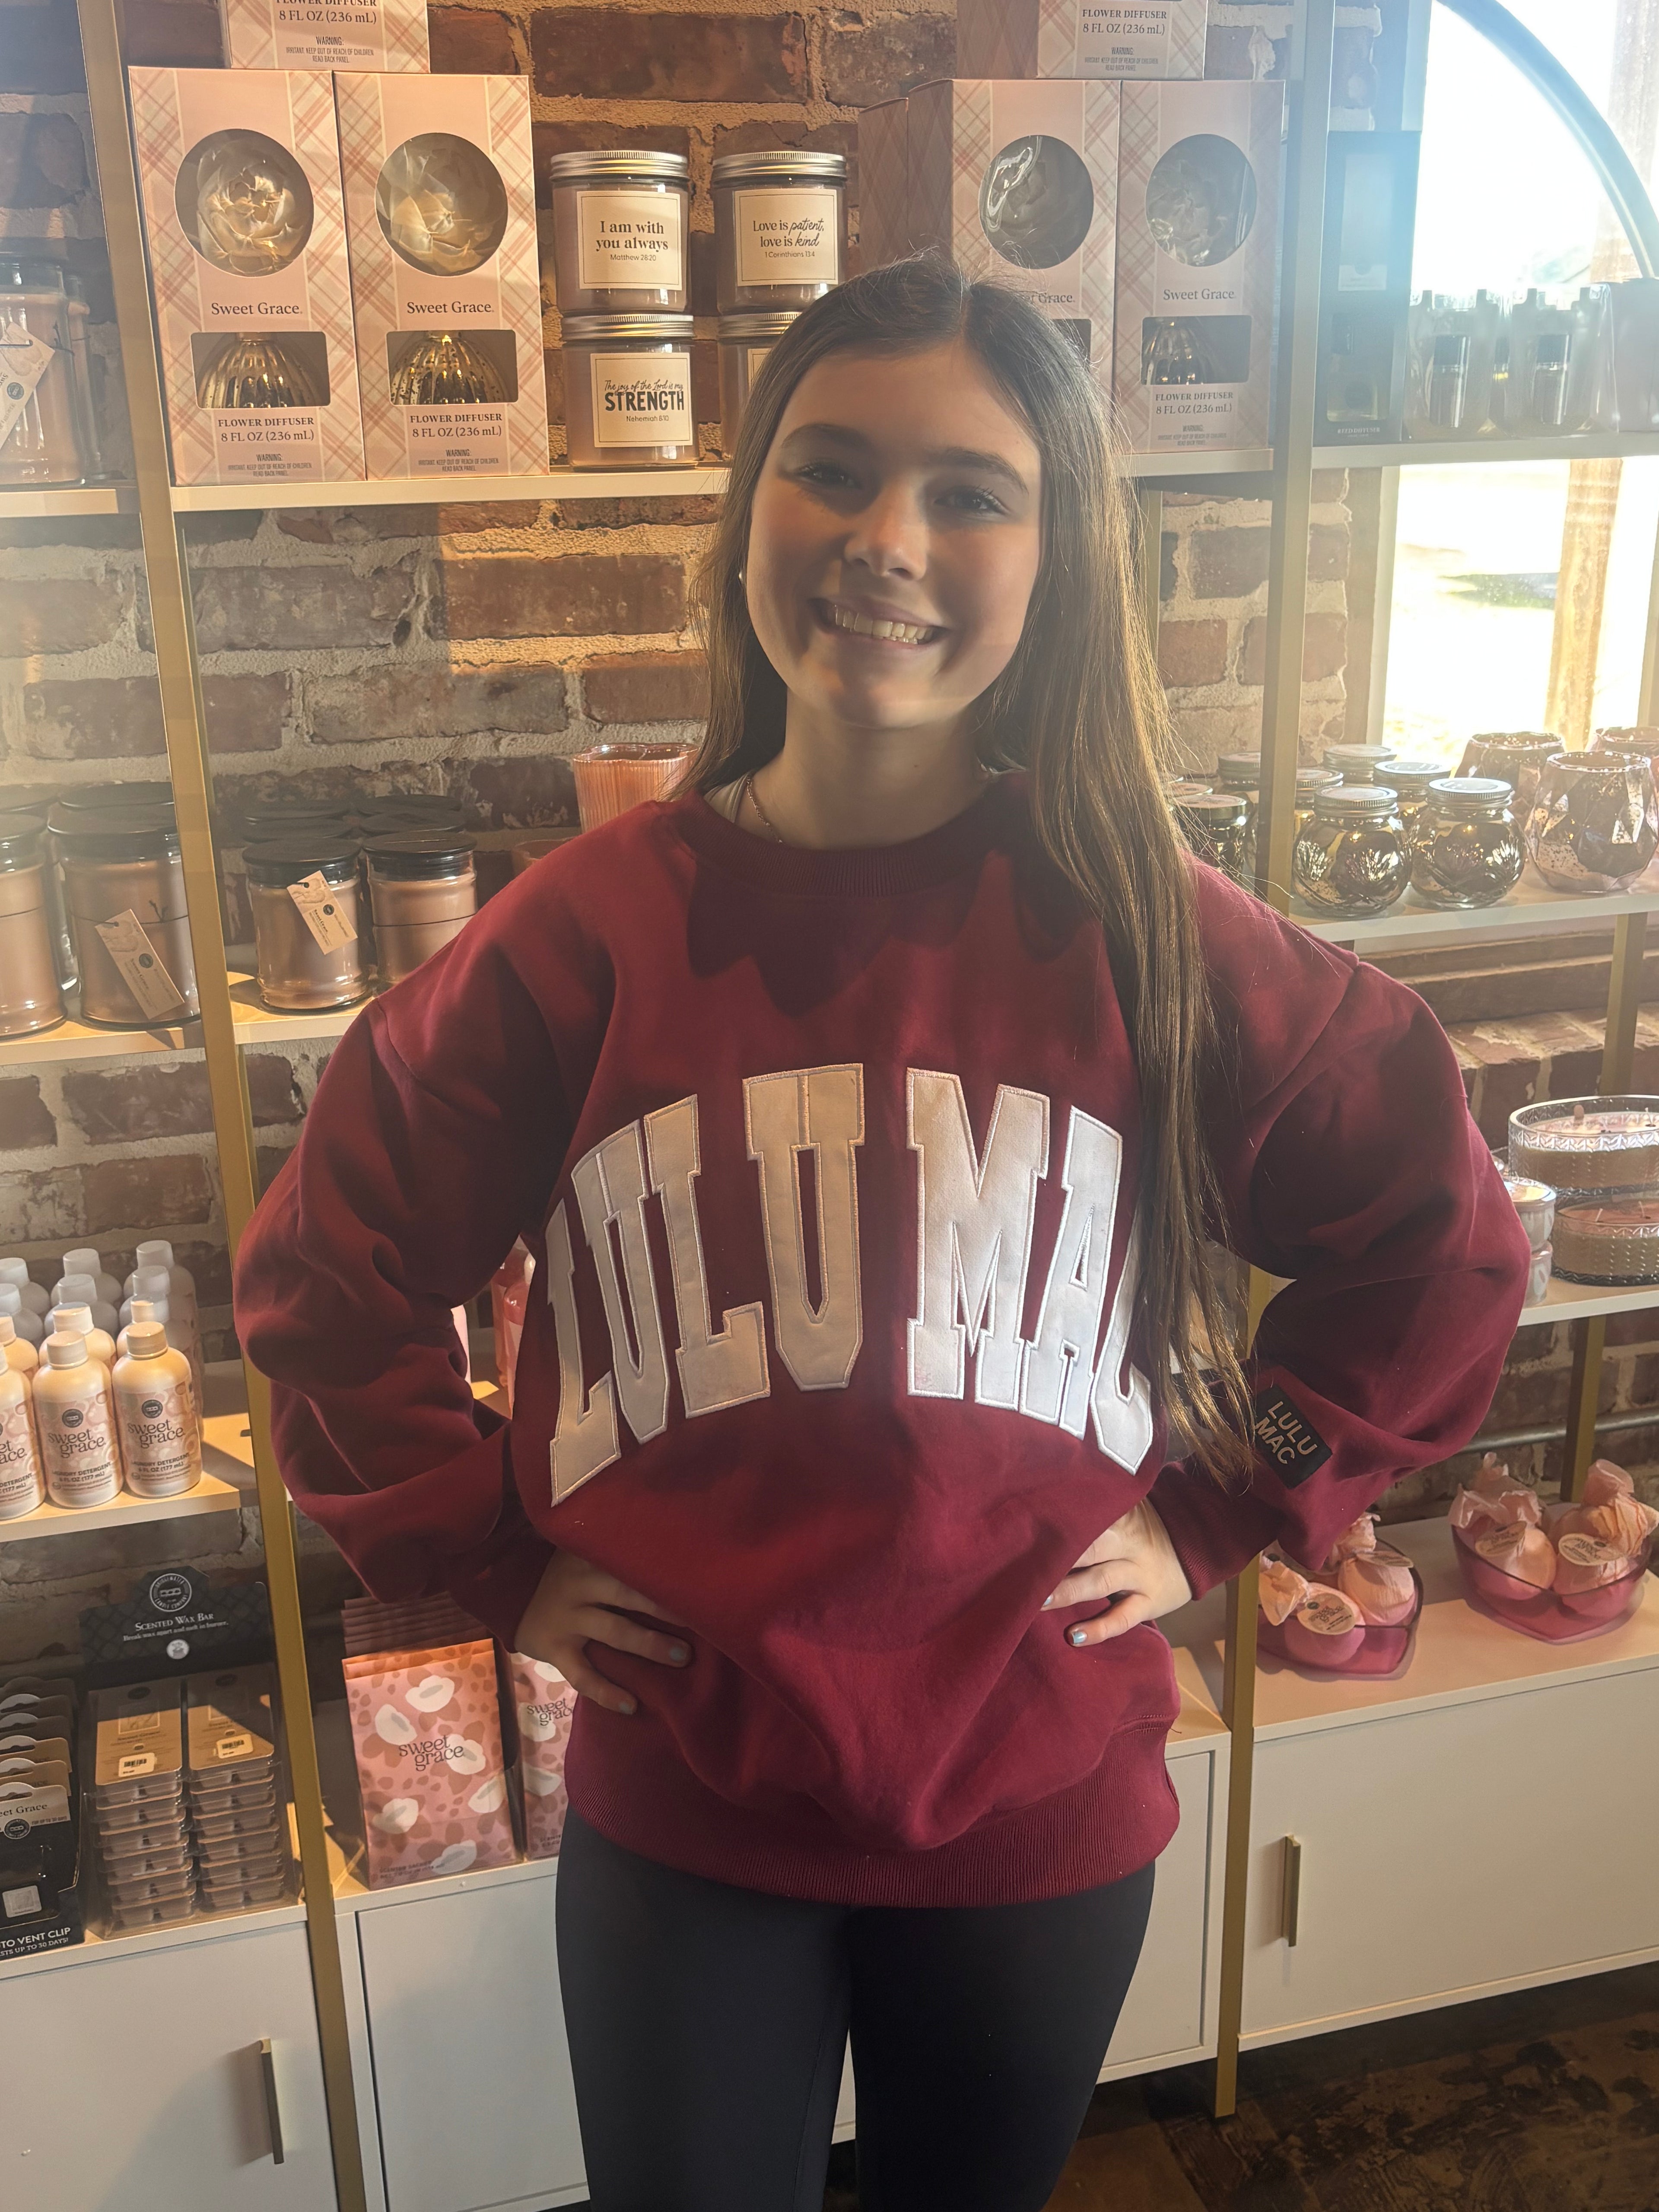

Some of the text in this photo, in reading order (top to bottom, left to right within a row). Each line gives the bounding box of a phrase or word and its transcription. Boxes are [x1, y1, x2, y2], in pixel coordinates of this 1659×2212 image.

[280, 10, 376, 24] 8 FL OZ (236 mL)
[1083, 10, 1166, 19] FLOWER DIFFUSER
[1083, 23, 1165, 35] 8 FL OZ (236 mL)
[601, 221, 664, 234] I am with
[753, 218, 824, 235] Love is patient,
[596, 237, 668, 252] you always
[760, 232, 820, 247] love is kind
[1163, 289, 1198, 300] Sweet
[211, 302, 254, 315] Sweet
[407, 302, 448, 314] Sweet
[605, 380, 616, 391] The
[640, 379, 652, 390] the
[605, 391, 684, 411] STRENGTH
[1178, 405, 1191, 413] OZ
[1193, 404, 1213, 414] (236
[1216, 403, 1232, 413] mL)
[265, 418, 314, 426] DIFFUSER
[455, 413, 502, 422] DIFFUSER
[221, 429, 314, 442] 8 FL OZ (236 mL)
[413, 426, 502, 438] 8 FL OZ (236 mL)
[545, 1063, 1153, 1508] LULU MAC
[127, 1419, 172, 1434] sweet
[1268, 1401, 1318, 1456] LULU
[48, 1429, 93, 1443] sweet
[1254, 1417, 1295, 1465] MAC
[135, 1619, 173, 1631] SCENTED
[197, 1613, 214, 1621] BAR
[527, 1697, 568, 1714] sweet
[540, 1707, 572, 1726] grac
[399, 1735, 450, 1757] sweet
[415, 1746, 464, 1771] grace
[16, 1804, 48, 1813] Grace
[17, 1932, 45, 1944] VENT
[48, 1927, 70, 1938] CLIP
